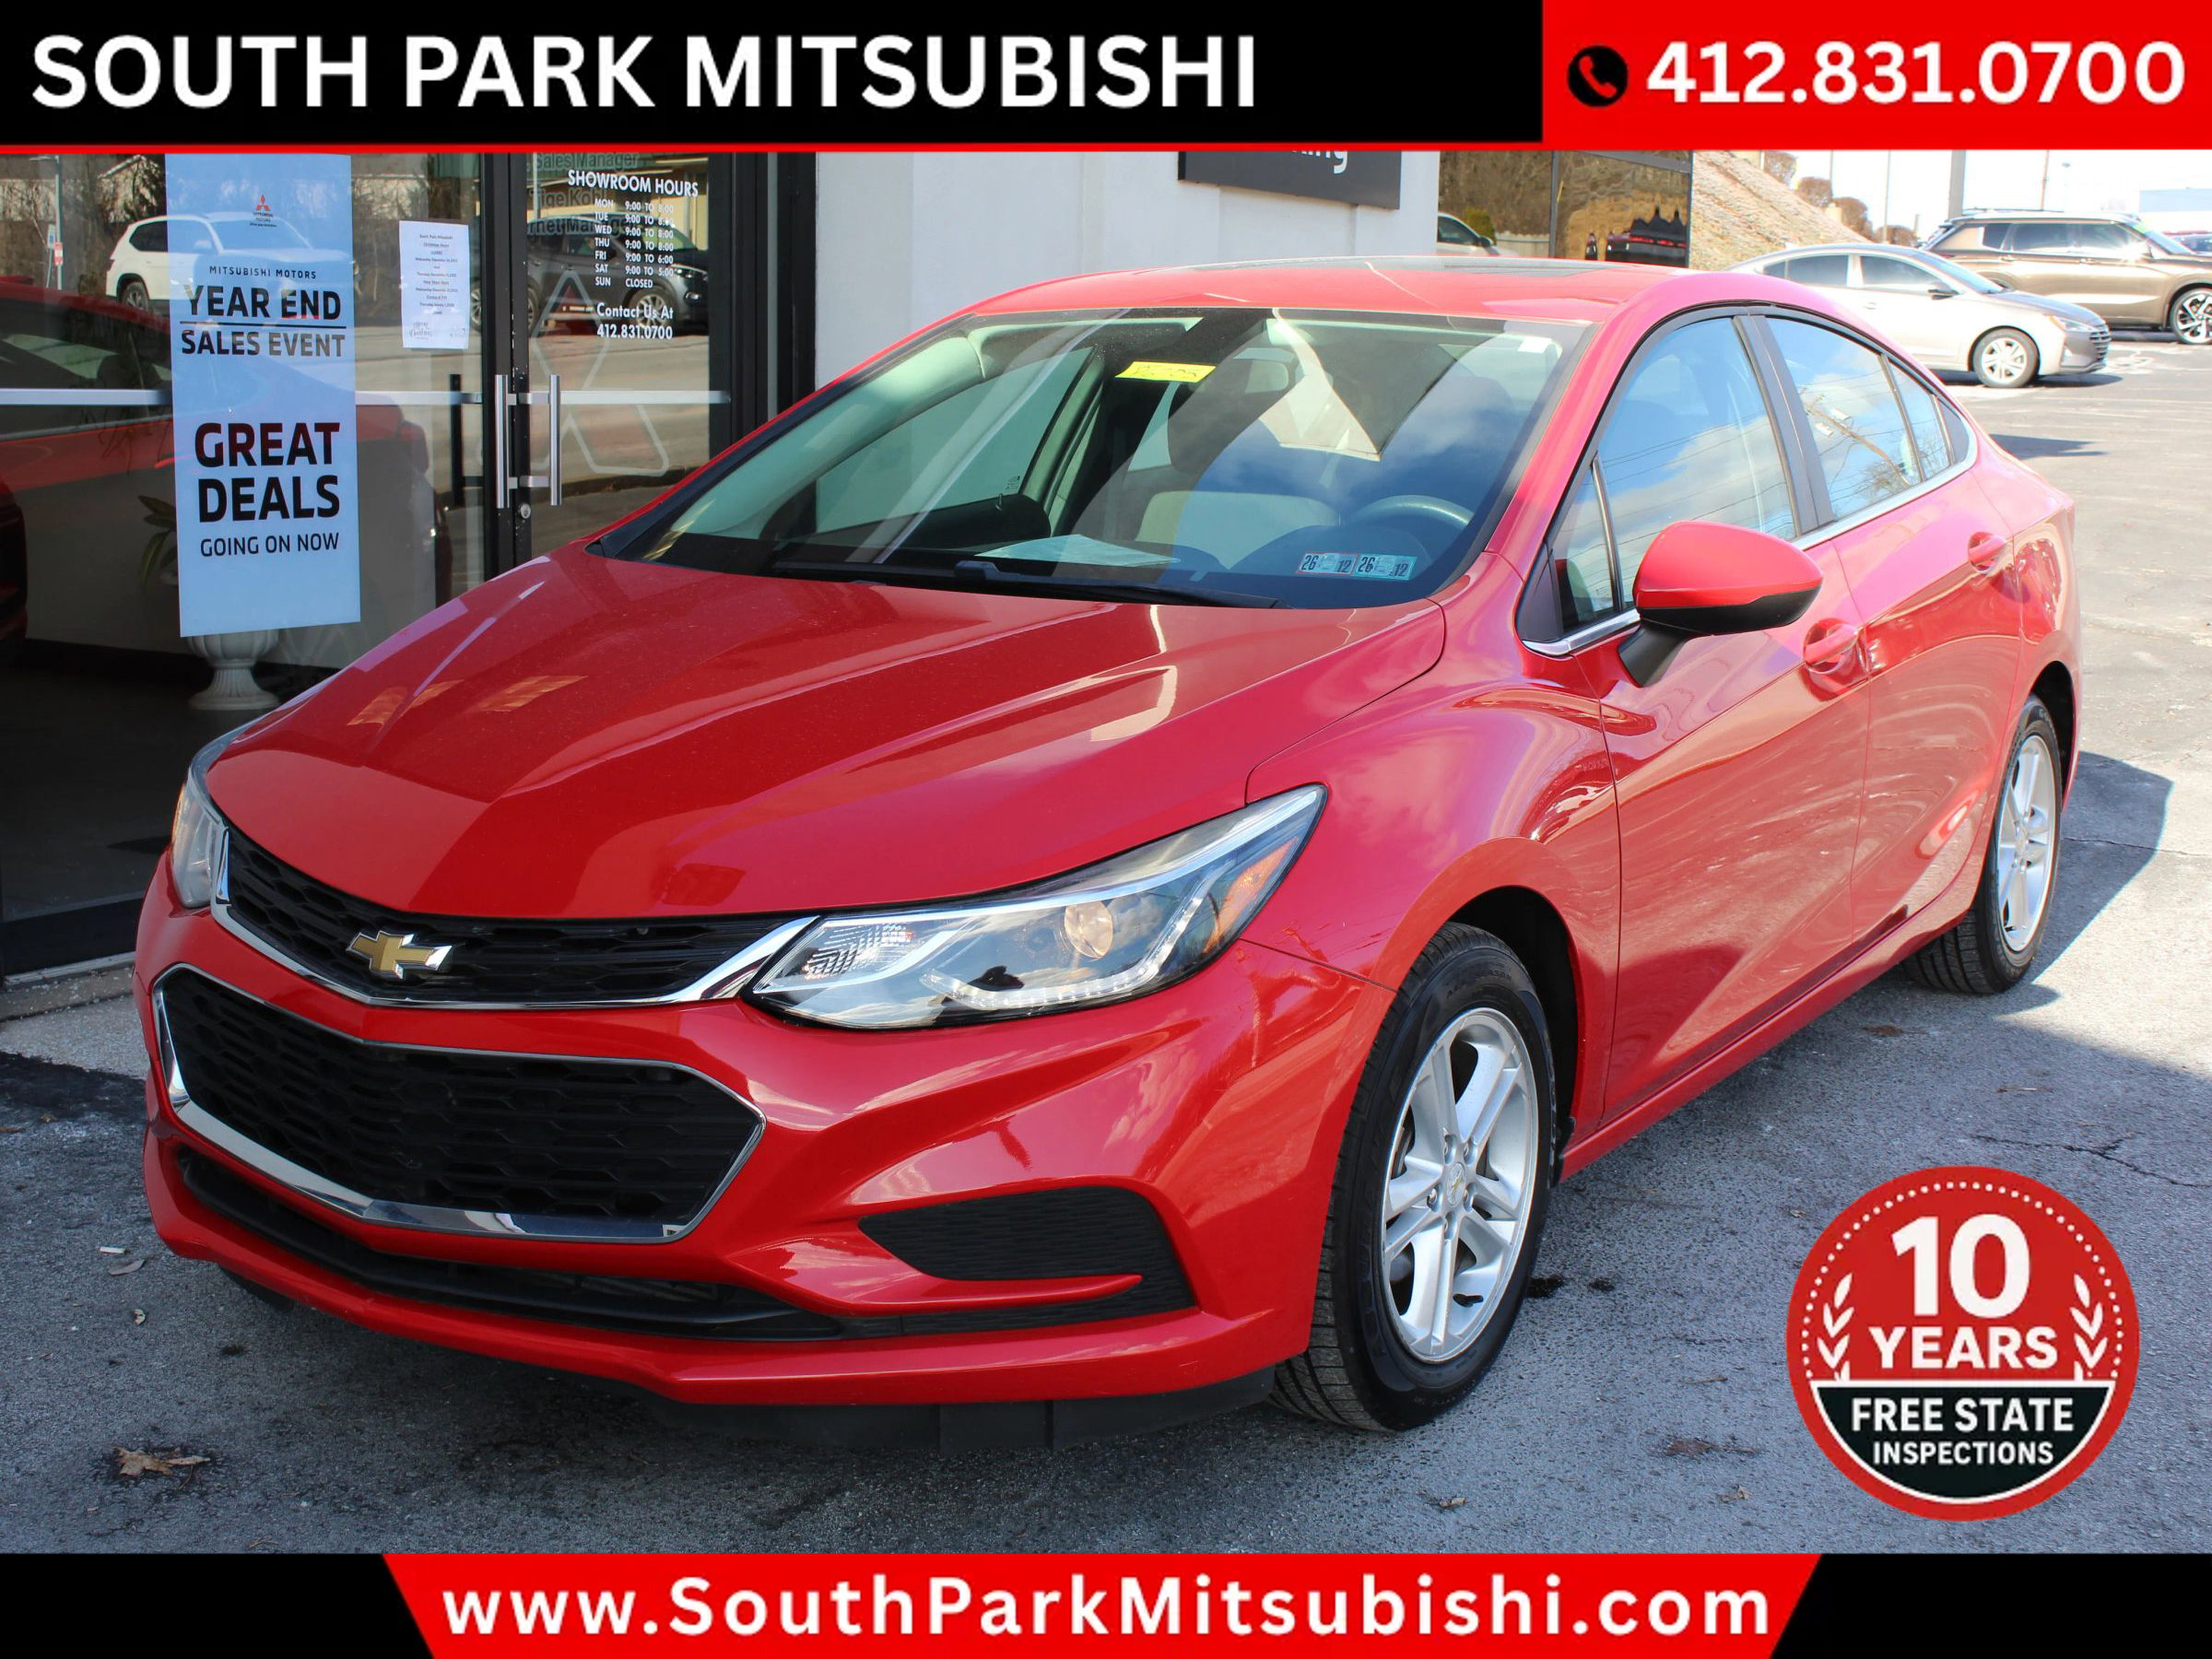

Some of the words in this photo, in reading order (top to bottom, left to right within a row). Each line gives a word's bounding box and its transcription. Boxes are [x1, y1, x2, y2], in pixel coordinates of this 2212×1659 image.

[568, 169, 651, 194] SHOWROOM
[655, 178, 699, 197] HOURS
[594, 198, 613, 208] MON
[625, 201, 641, 211] 9:00
[644, 203, 654, 212] TO
[594, 212, 608, 221] TUE
[625, 214, 641, 224] 9:00
[644, 216, 653, 225] TO
[594, 224, 612, 234] WED
[625, 227, 641, 237] 9:00
[644, 229, 654, 238] TO
[594, 238, 609, 247] THU
[625, 240, 641, 249] 9:00
[644, 241, 654, 251] TO
[658, 242, 674, 252] 8:00
[594, 251, 606, 260] FRI
[625, 253, 641, 262] 9:00
[644, 253, 654, 263] TO
[657, 254, 674, 264] 6:00
[209, 265, 271, 276] MITSUBISHI
[276, 269, 316, 279] MOTORS
[594, 264, 608, 273] SAT
[625, 265, 641, 275] 9:00
[643, 266, 653, 276] TO
[658, 267, 674, 276] 5:00
[594, 276, 611, 287] SUN
[625, 278, 653, 288] CLOSED
[183, 284, 270, 318] YEAR
[281, 288, 341, 320] END
[596, 301, 640, 318] Contact
[644, 304, 657, 319] Us
[662, 305, 674, 320] At
[596, 324, 673, 339] 412.831.0700
[181, 329, 260, 356] SALES
[268, 332, 346, 358] EVENT
[194, 422, 340, 468] GREAT
[198, 475, 340, 523] DEALS
[200, 536, 259, 558] GOING
[265, 535, 290, 553] ON
[297, 533, 339, 552] NOW
[1301, 555, 1319, 571] 26
[1337, 559, 1352, 573] 12
[1358, 556, 1375, 572] 26
[1394, 563, 1408, 576] 12
